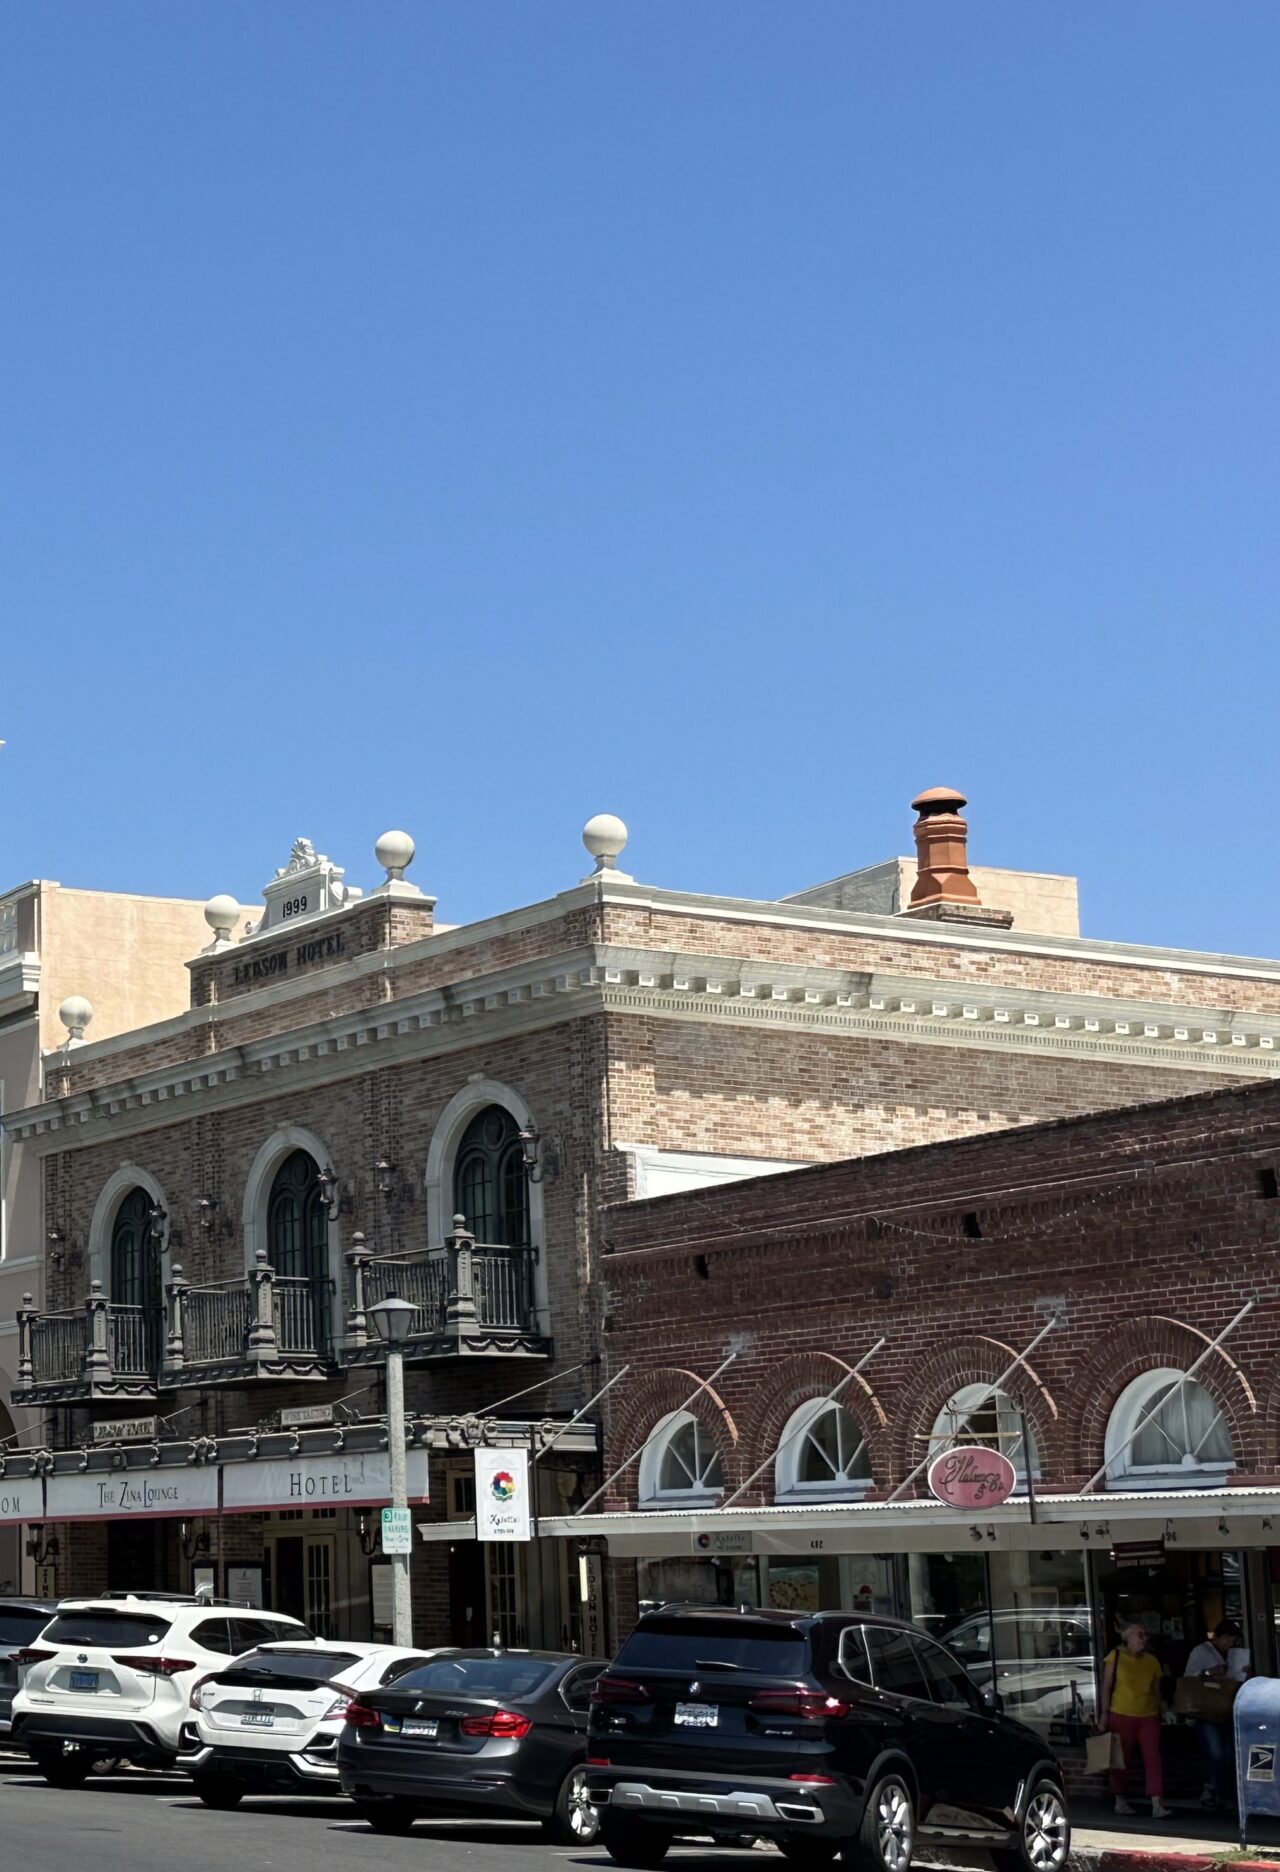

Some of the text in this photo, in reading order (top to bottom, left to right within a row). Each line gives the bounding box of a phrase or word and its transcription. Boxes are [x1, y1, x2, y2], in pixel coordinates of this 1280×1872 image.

[282, 896, 307, 918] 1999
[235, 933, 345, 983] LEDSON HOTEL
[119, 1481, 141, 1509] ZINA
[143, 1480, 179, 1508] LOUNGE
[289, 1473, 352, 1496] HOTEL
